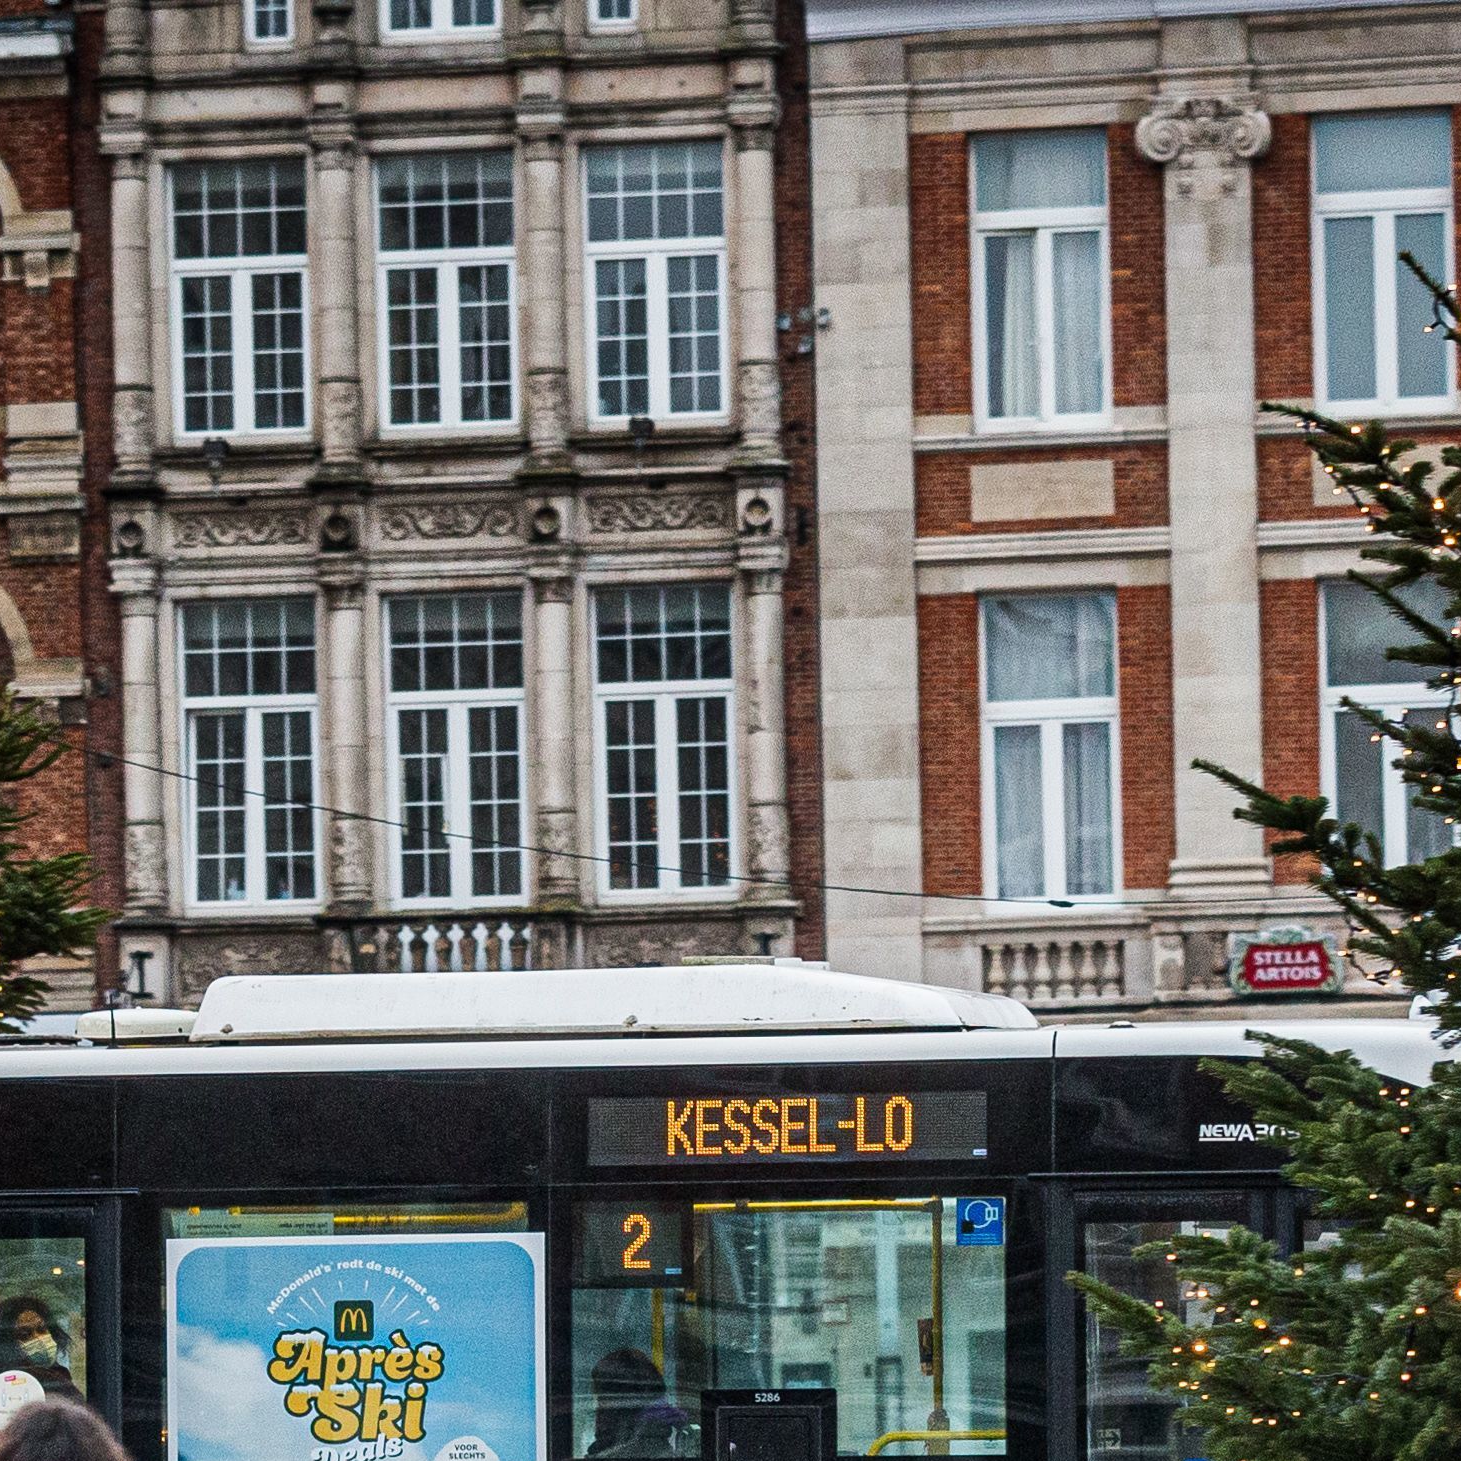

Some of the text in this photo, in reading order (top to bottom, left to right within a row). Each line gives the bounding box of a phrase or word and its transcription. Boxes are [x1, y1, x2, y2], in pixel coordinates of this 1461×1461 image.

[1253, 950, 1320, 966] STELLA
[1253, 966, 1322, 981] ARTOIS
[666, 1095, 913, 1156] KESSEL-LO
[622, 1214, 652, 1270] 2
[337, 1259, 364, 1270] redt
[366, 1260, 382, 1272] de
[384, 1265, 404, 1280] ski
[404, 1275, 428, 1296] met
[426, 1295, 440, 1312] de
[267, 1327, 444, 1388] Après
[284, 1382, 428, 1444] Ski
[754, 1392, 781, 1403] 5286
[449, 1452, 486, 1460] SLECHTS
[454, 1444, 478, 1452] VOOR
